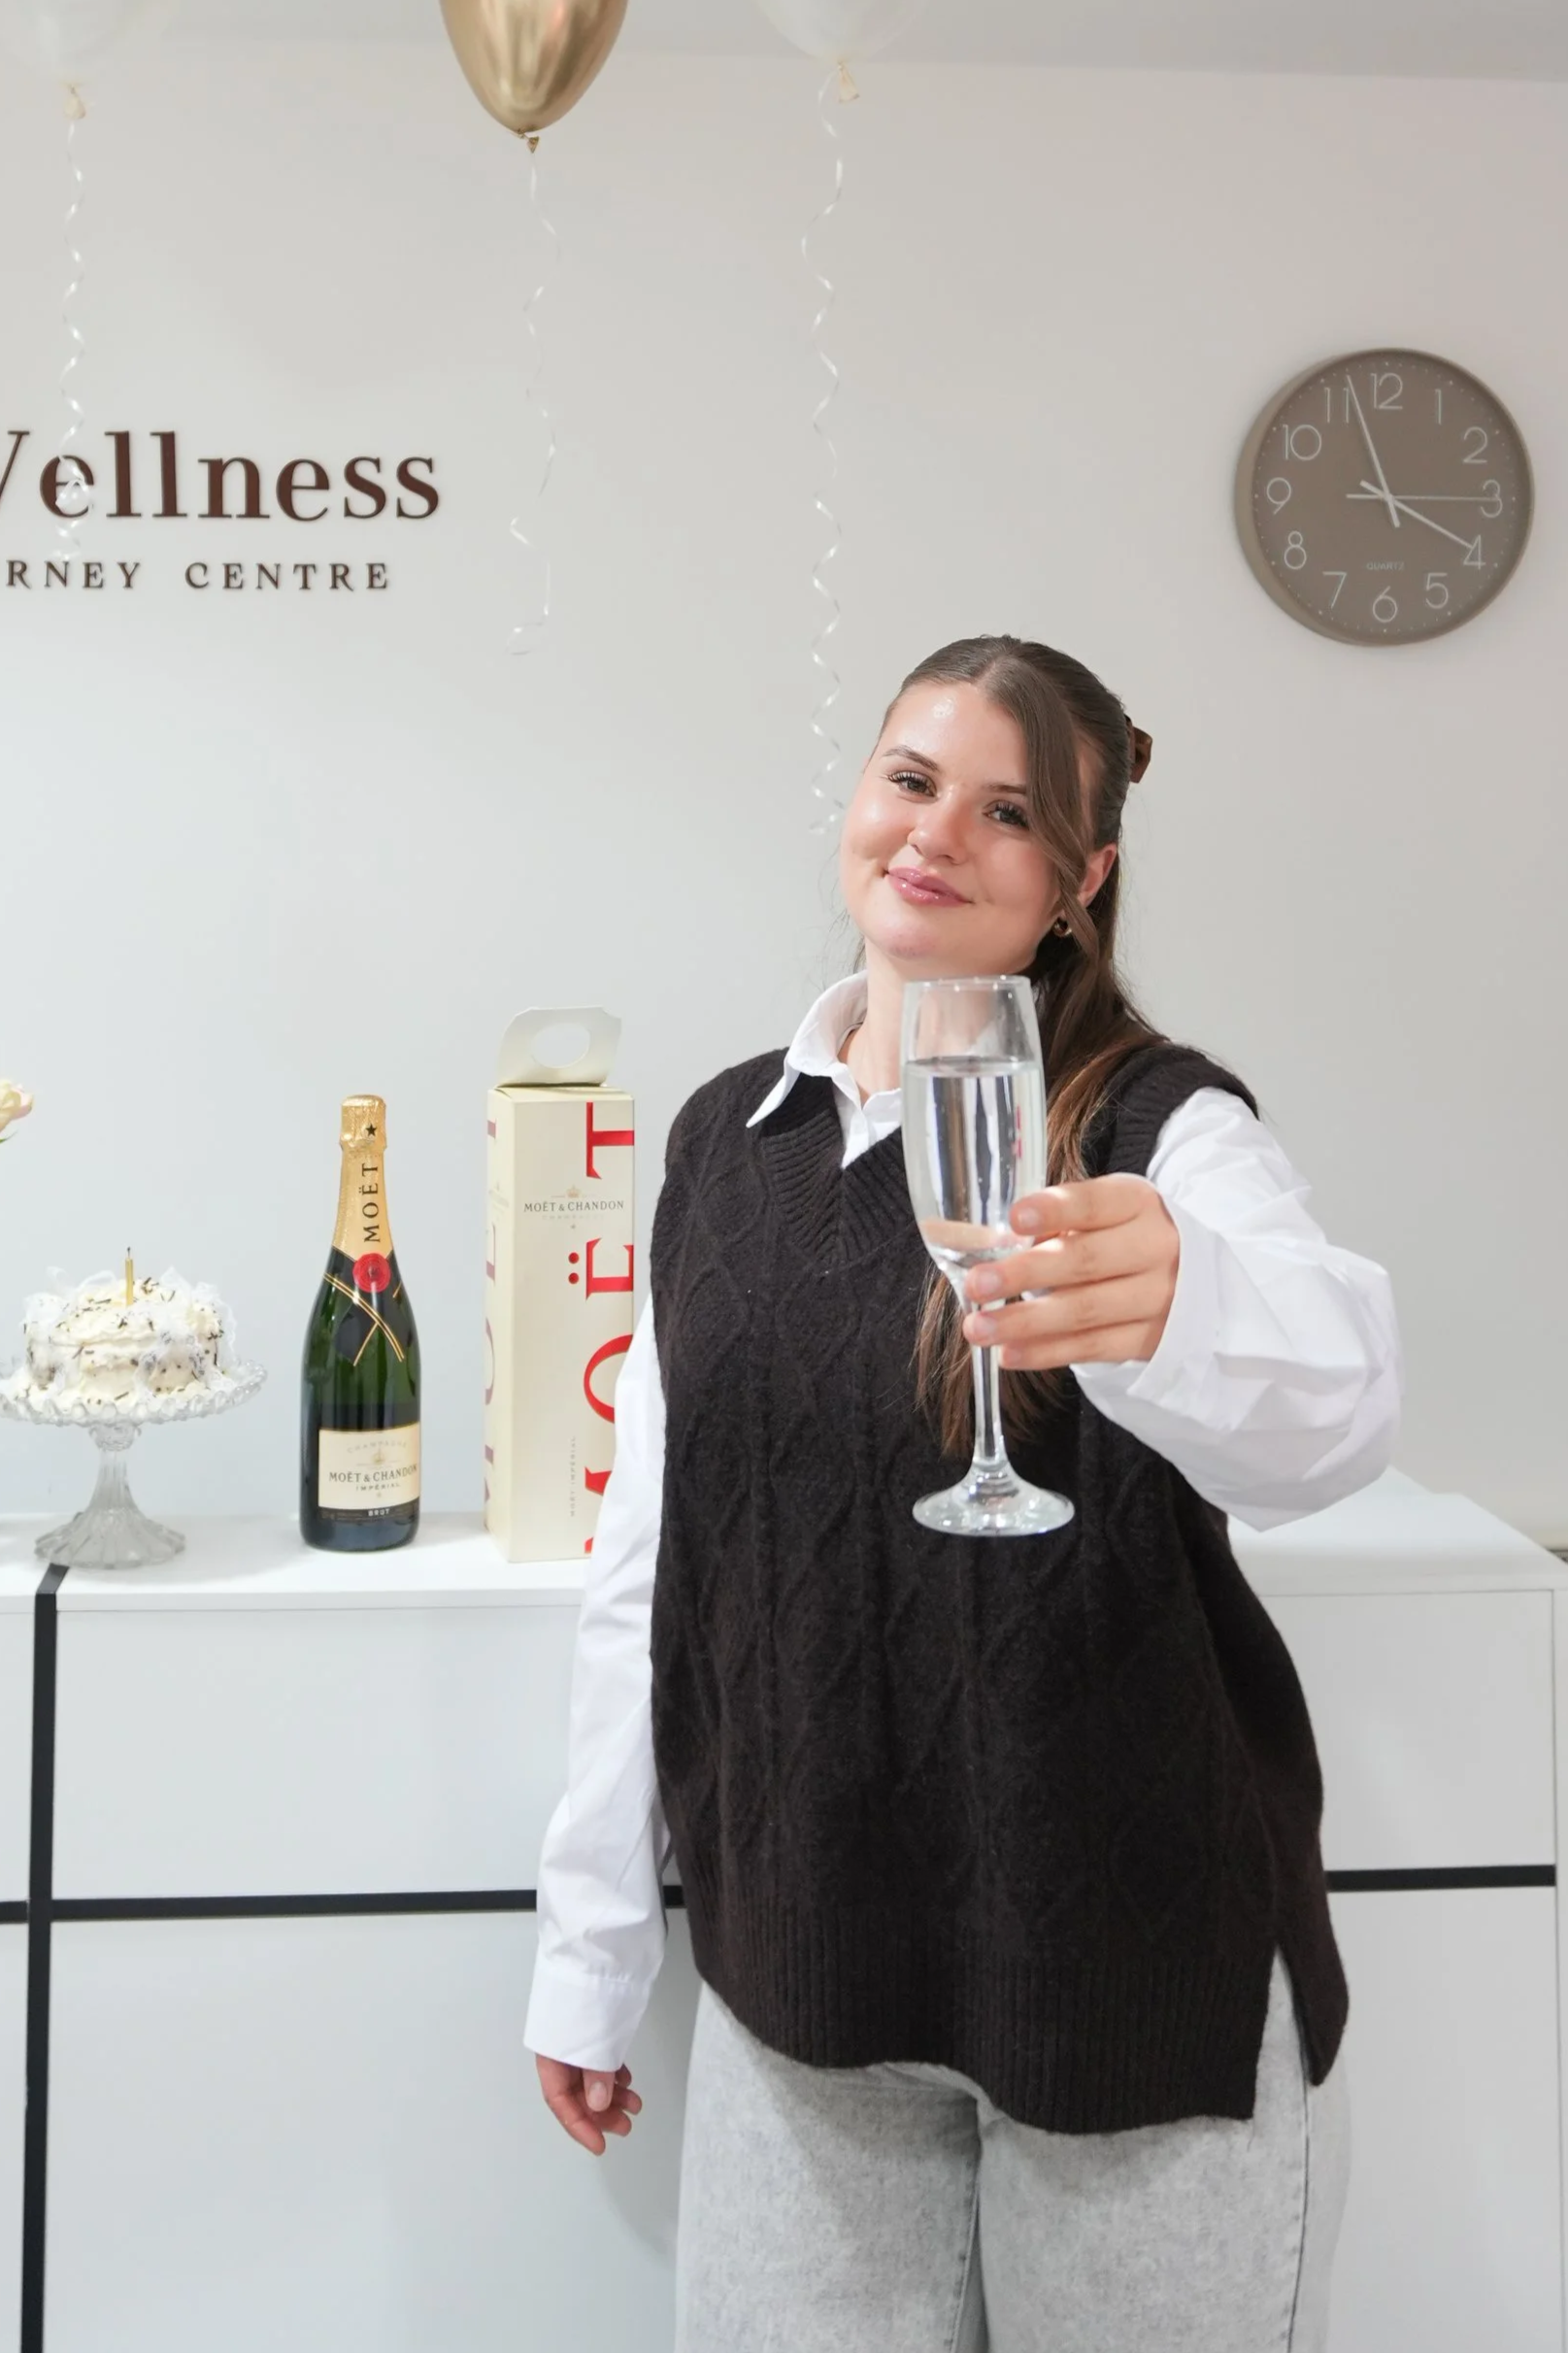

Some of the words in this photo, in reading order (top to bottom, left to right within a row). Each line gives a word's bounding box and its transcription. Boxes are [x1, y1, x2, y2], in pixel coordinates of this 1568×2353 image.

[1323, 387, 1351, 424] 11
[1370, 372, 1404, 411] 12
[1434, 388, 1443, 425] 1
[1282, 423, 1322, 461] 10
[1462, 425, 1488, 464] 2
[1266, 477, 1292, 515] 9
[1480, 479, 1503, 518] 3
[1284, 530, 1307, 570] 8
[1366, 560, 1405, 572] QUARTZ
[1462, 534, 1486, 570] 4
[6, 559, 141, 589] RNEY
[183, 561, 390, 591] CENTRE
[1322, 571, 1348, 610] 7
[1425, 572, 1449, 609] 5
[1372, 586, 1398, 622] 6
[359, 1163, 380, 1243] MOËT
[523, 1200, 556, 1213] MOËT
[558, 1203, 565, 1212] &
[567, 1200, 624, 1212] CHANDON
[328, 1471, 361, 1483] MOËT
[363, 1473, 371, 1483] &
[372, 1463, 417, 1482] CHANDON
[368, 1508, 390, 1517] BRUT
